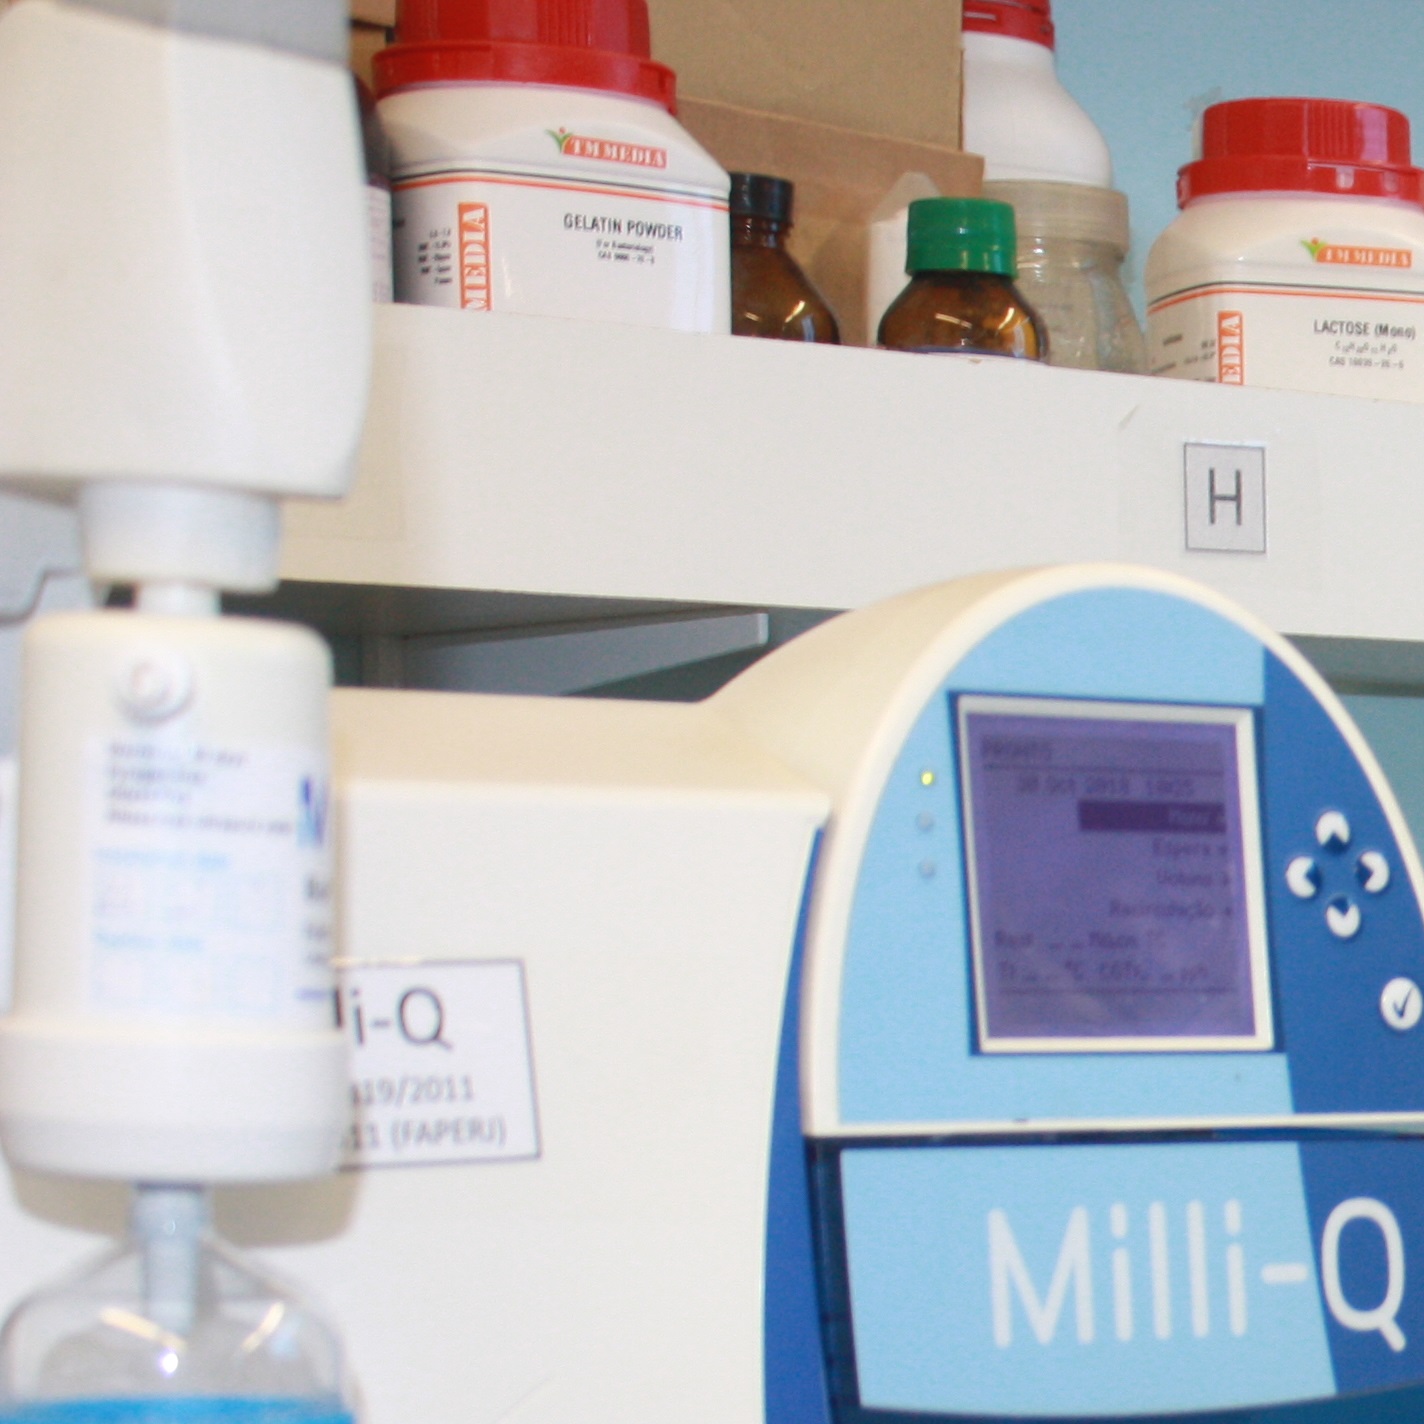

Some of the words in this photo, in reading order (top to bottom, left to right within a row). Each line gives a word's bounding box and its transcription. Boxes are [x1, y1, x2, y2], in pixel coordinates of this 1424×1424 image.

[603, 141, 666, 168] MEDIA
[563, 212, 622, 233] GELATIN
[626, 219, 683, 241] POWDER
[1313, 319, 1369, 336] LACTOSE
[1208, 466, 1243, 526] H
[389, 1114, 507, 1151] (FAPERJ)
[988, 1197, 1406, 1351] Milli-Q
